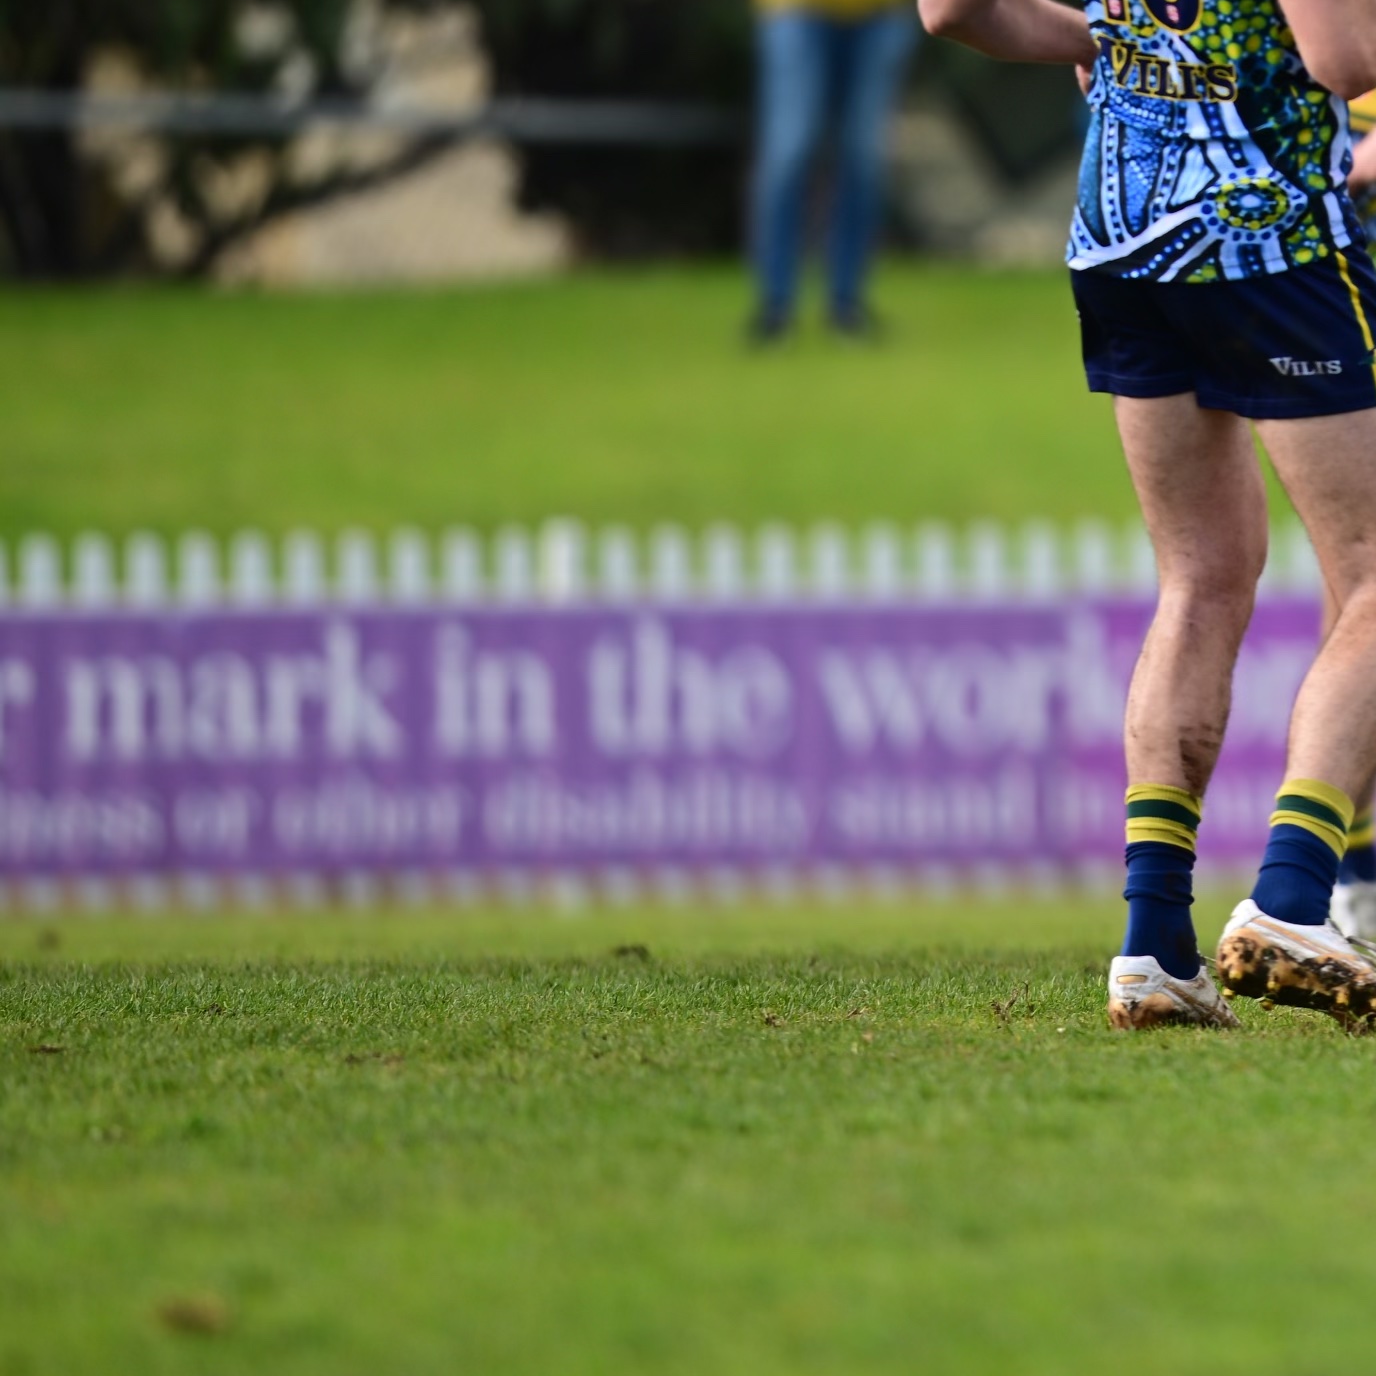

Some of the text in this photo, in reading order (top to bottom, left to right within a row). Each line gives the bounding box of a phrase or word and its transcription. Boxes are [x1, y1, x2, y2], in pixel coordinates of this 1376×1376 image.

[66, 620, 402, 760] mark
[436, 620, 556, 758] in
[588, 614, 792, 760] the
